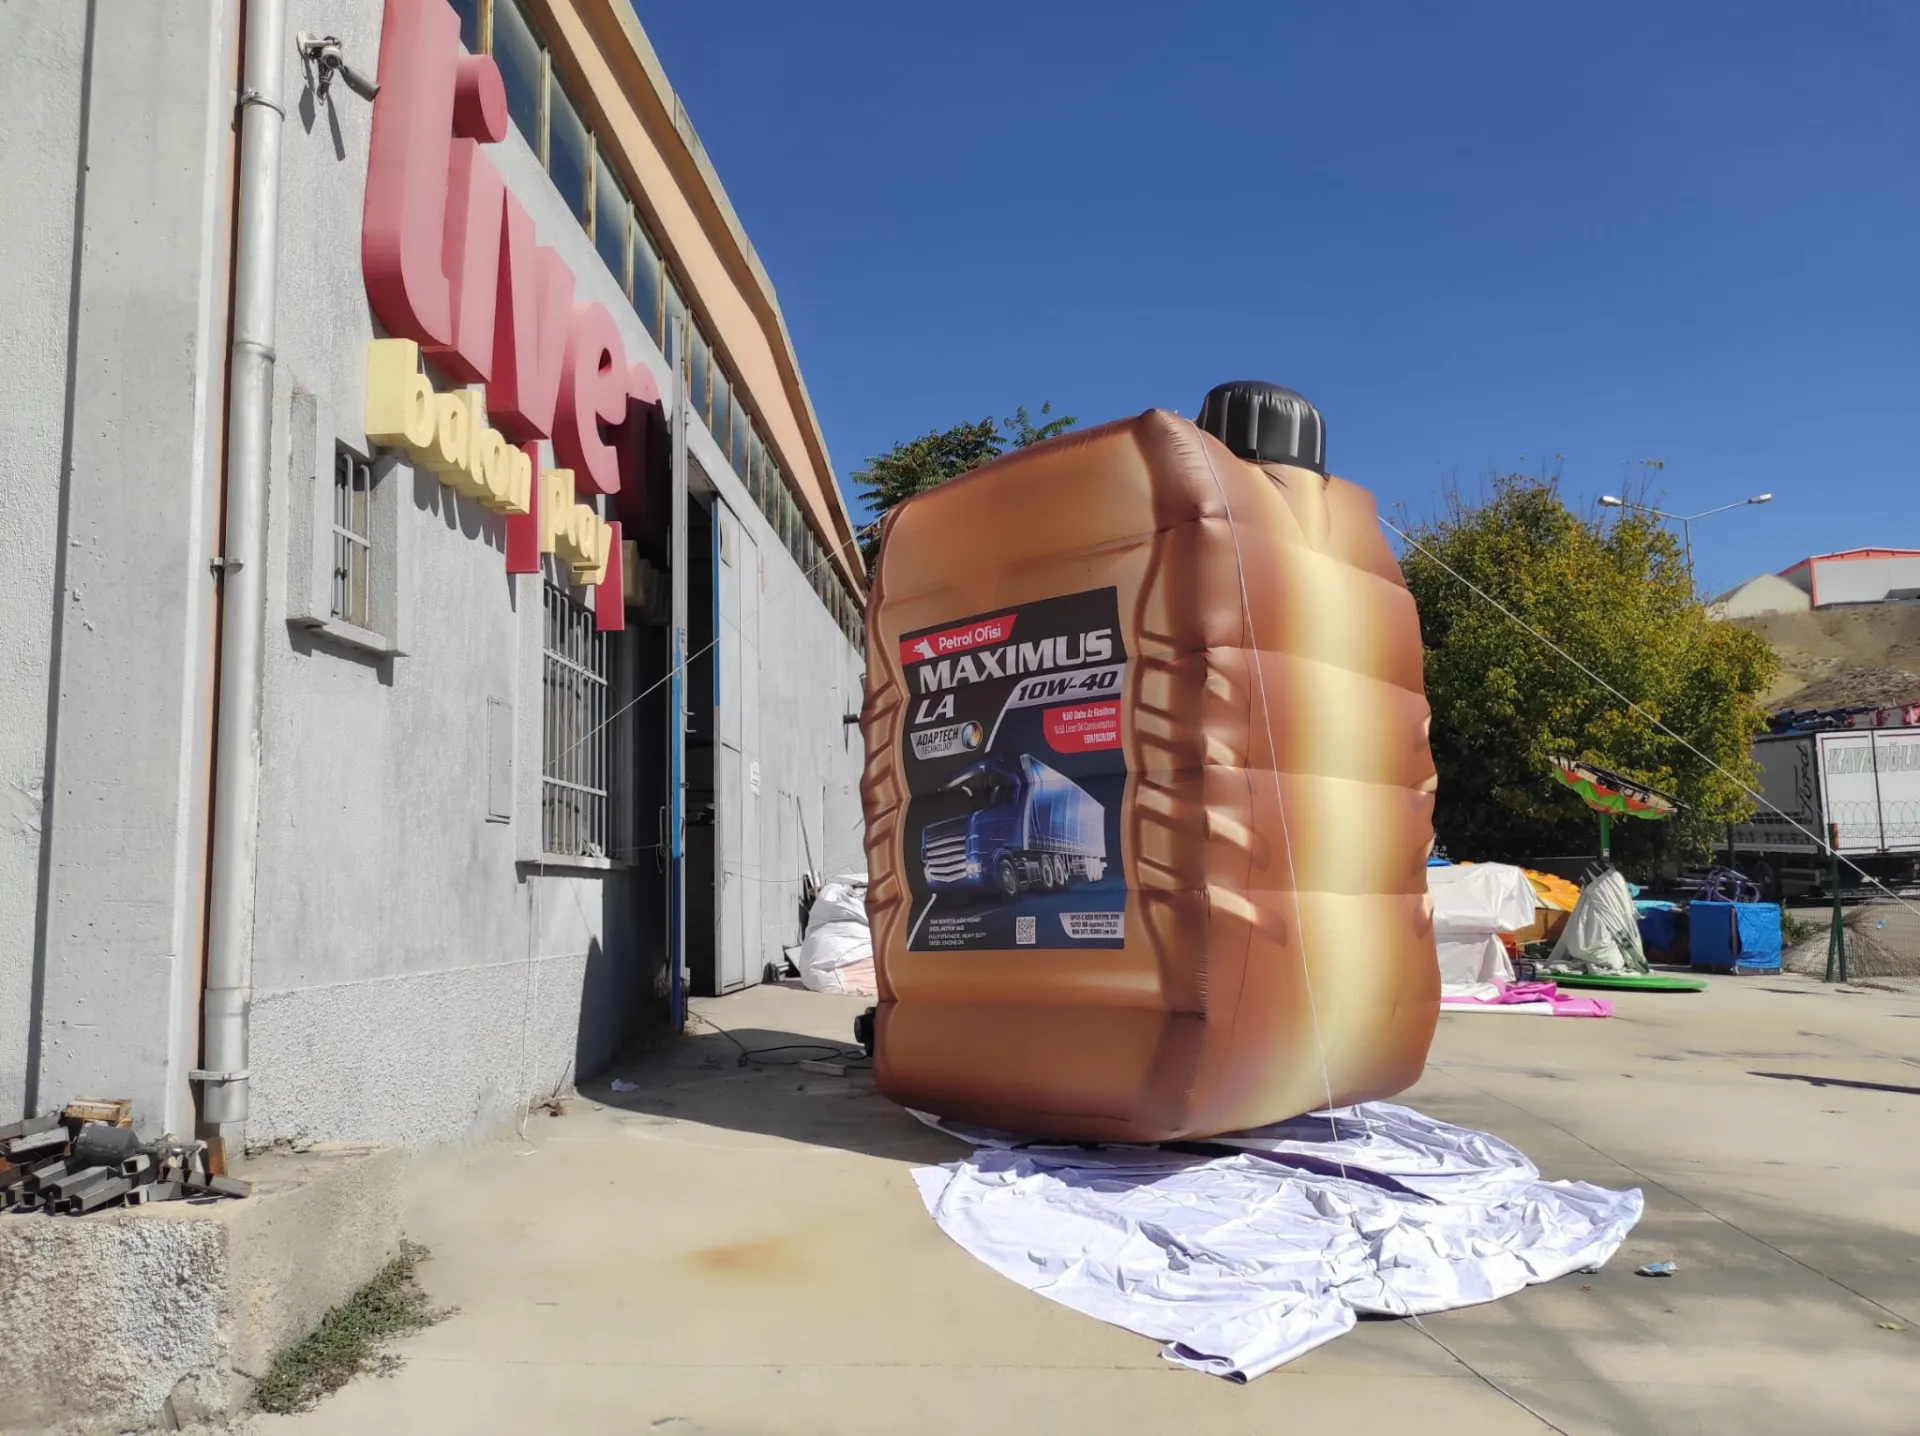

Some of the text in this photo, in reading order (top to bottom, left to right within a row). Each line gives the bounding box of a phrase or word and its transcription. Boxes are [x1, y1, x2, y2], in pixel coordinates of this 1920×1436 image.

[366, 337, 532, 515] balon
[541, 467, 613, 586] play
[939, 623, 1001, 650] Petrol Ofisi
[919, 628, 1112, 694] MAXIMUS
[914, 670, 1118, 724] LA 10W-40
[916, 727, 959, 747] ADAPTECH
[922, 742, 952, 755] TECHNOLOGY
